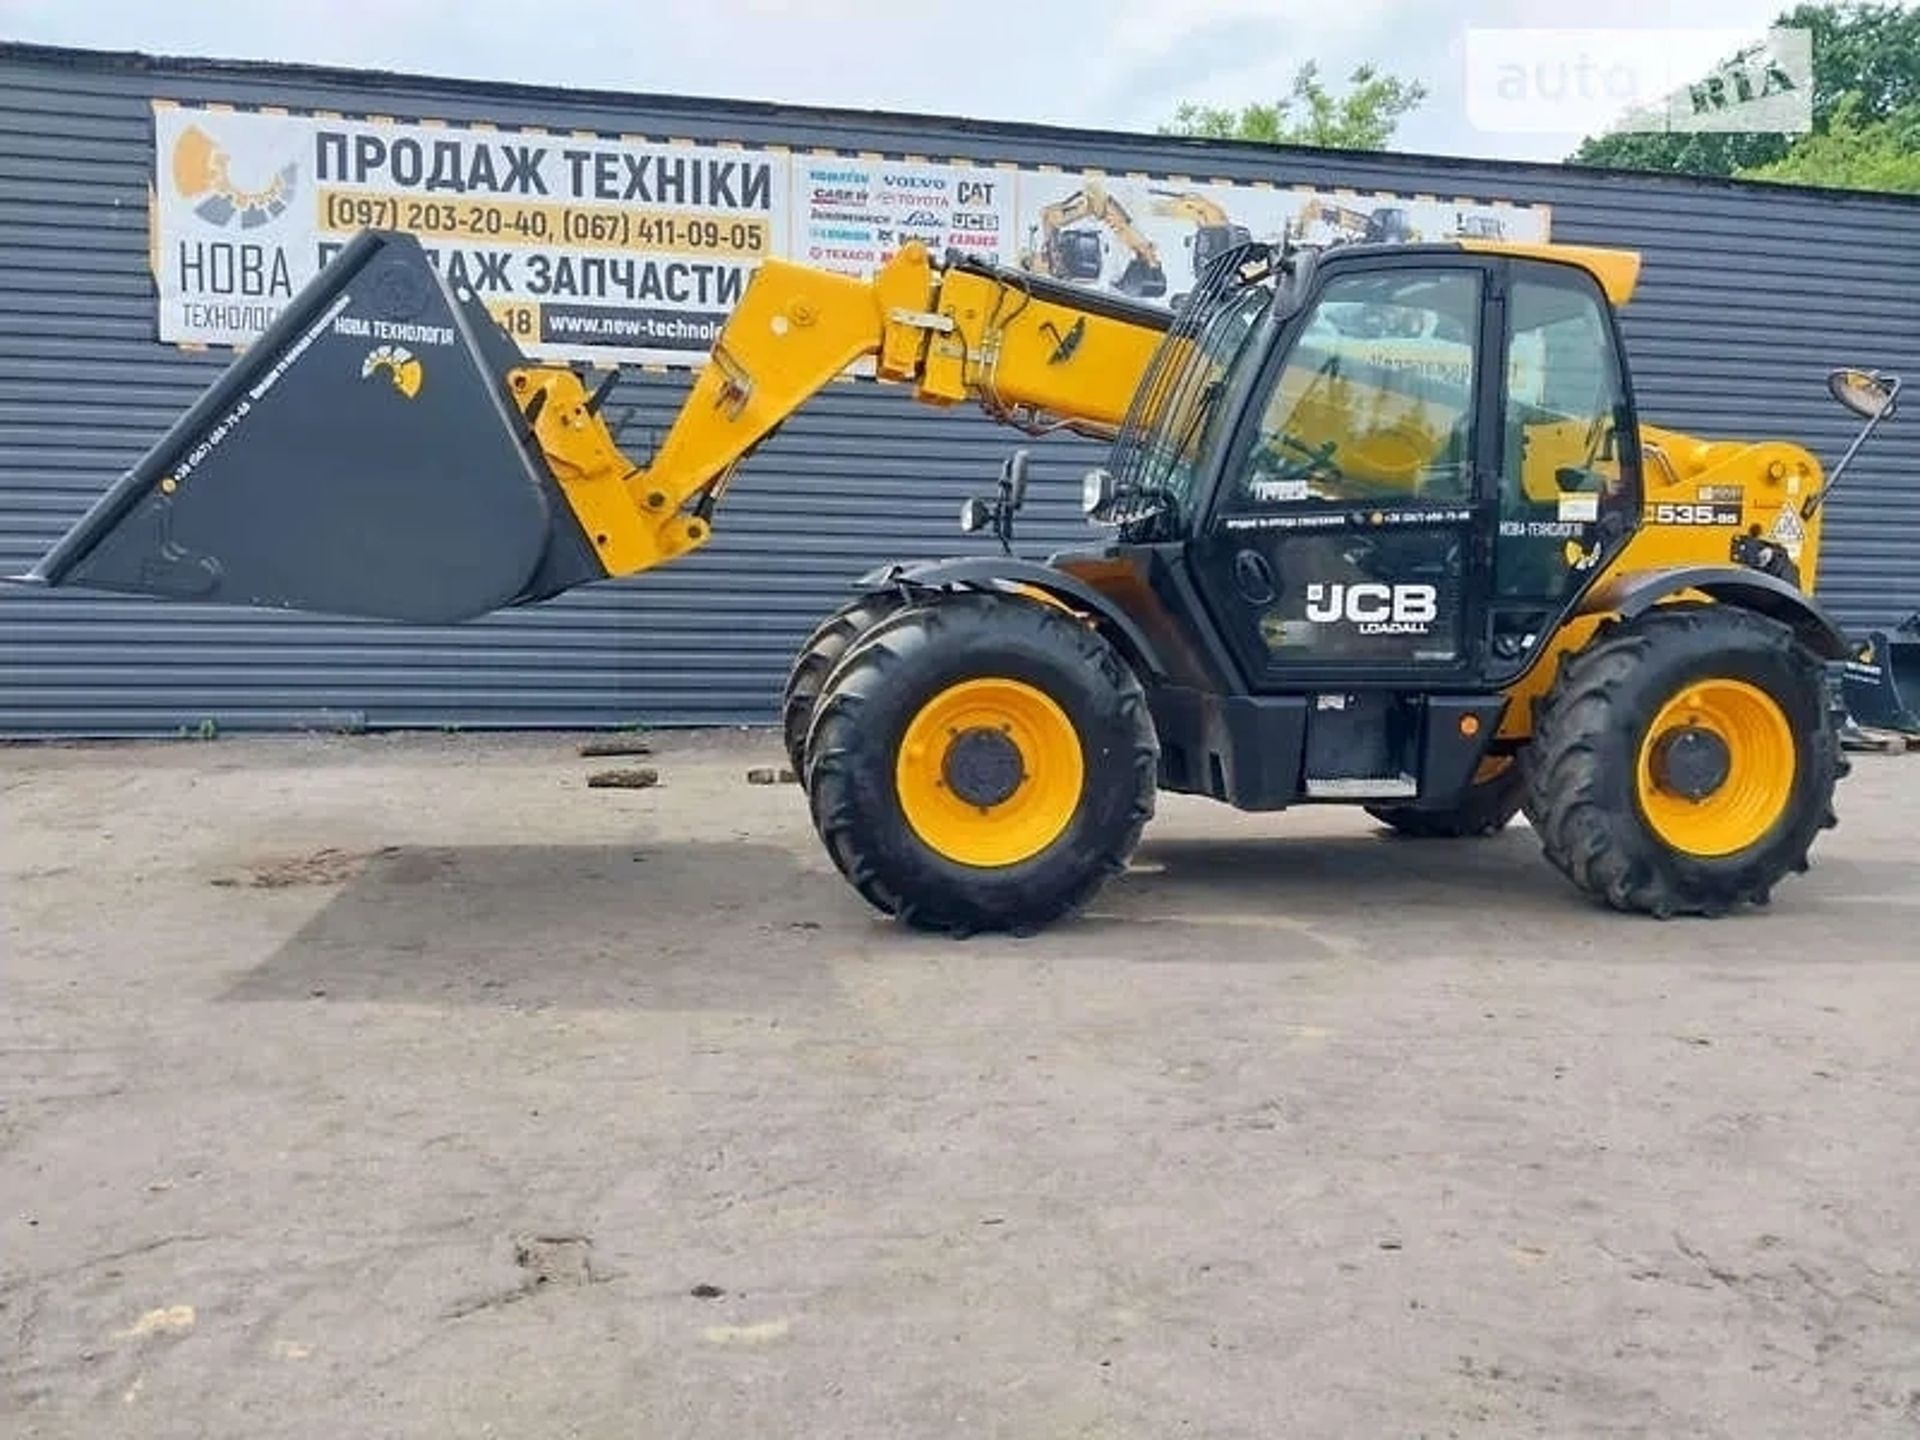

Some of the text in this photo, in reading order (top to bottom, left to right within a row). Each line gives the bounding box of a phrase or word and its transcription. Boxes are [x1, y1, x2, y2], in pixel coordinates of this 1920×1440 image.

[316, 132, 771, 209] ПРОДАЖ ТЕХНІКИ
[884, 175, 945, 190] VOLVO
[898, 193, 949, 208] TOYOTA
[957, 181, 994, 204] CAT
[327, 193, 763, 251] (097) 203-20-40, (067) 411-09-05
[180, 240, 292, 299] НОВА
[526, 253, 758, 307] ЗАПЧАСТИ
[1306, 583, 1437, 623] JCB
[1359, 622, 1429, 635] LOADALL
